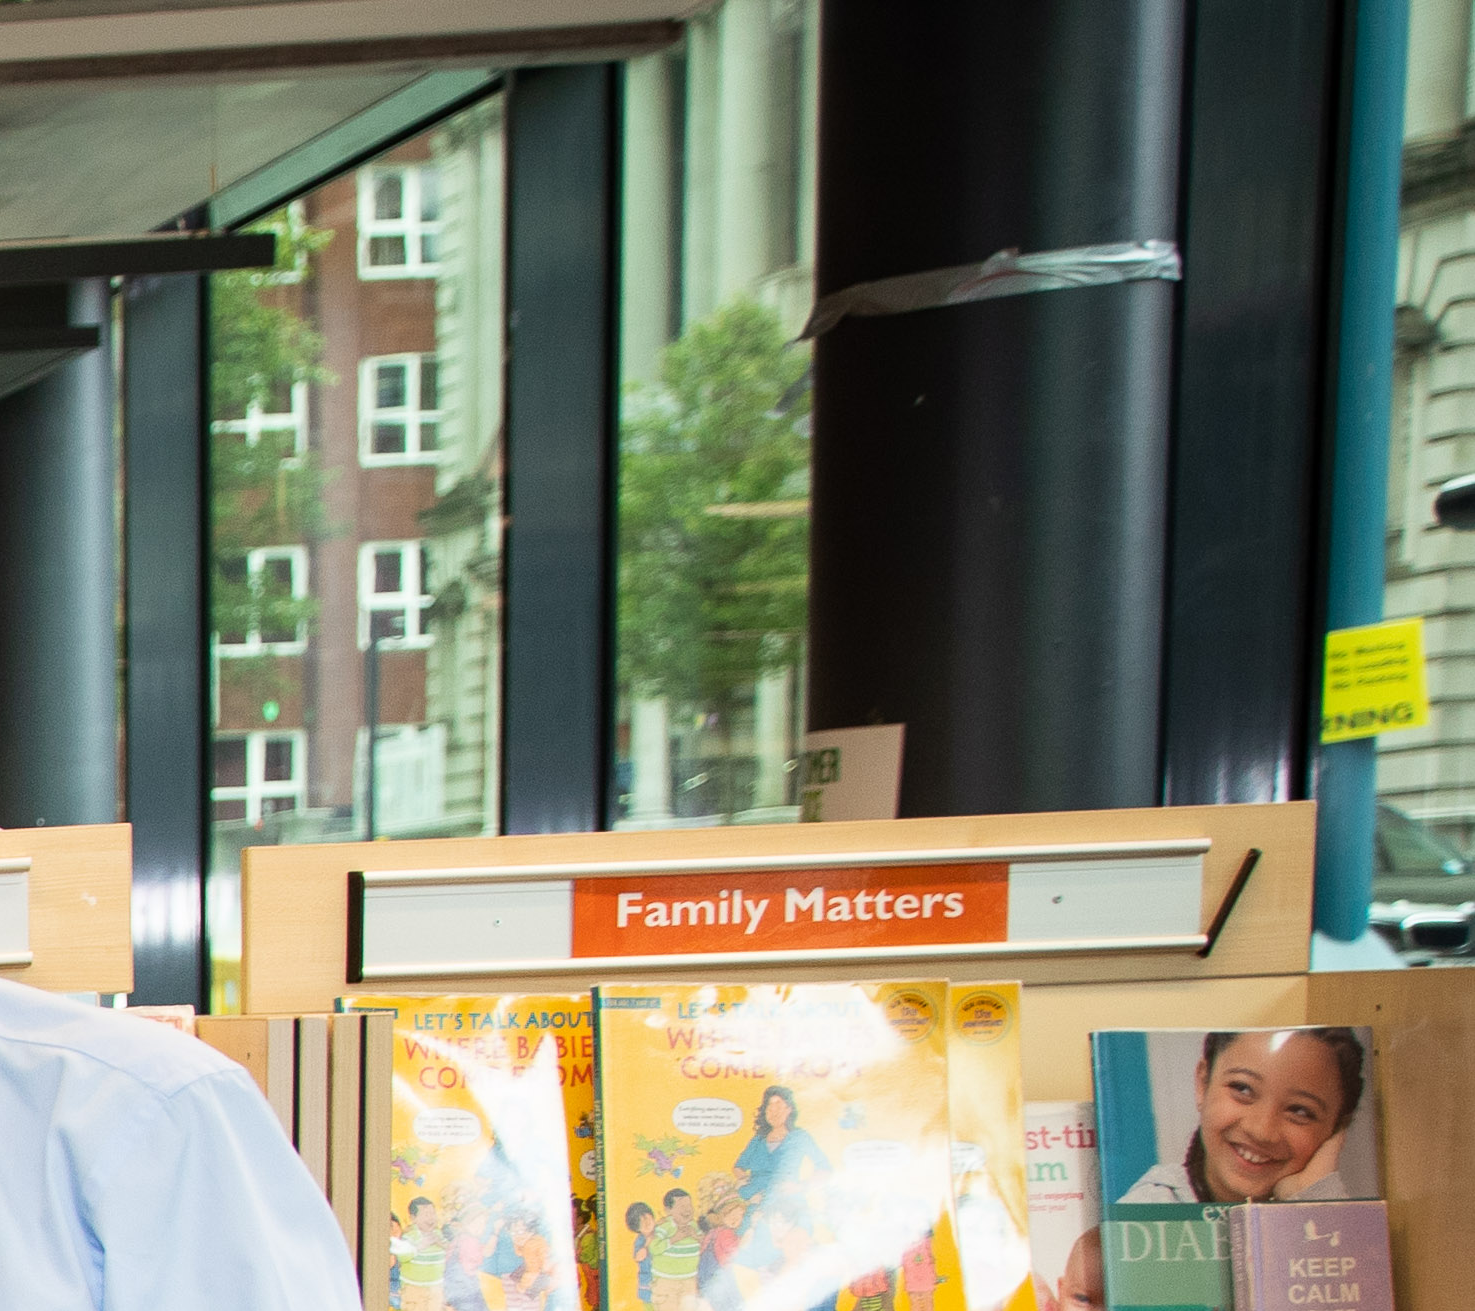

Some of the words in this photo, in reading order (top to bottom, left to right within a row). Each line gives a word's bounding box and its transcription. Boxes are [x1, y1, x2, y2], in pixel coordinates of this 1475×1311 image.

[616, 888, 770, 935] Family
[783, 887, 966, 924] Matters
[413, 1010, 464, 1031] LET'S
[468, 1009, 508, 1030] TALK
[511, 1008, 595, 1030] ABOUT
[1288, 1257, 1356, 1278] KEEP
[1287, 1284, 1360, 1303] CALM
